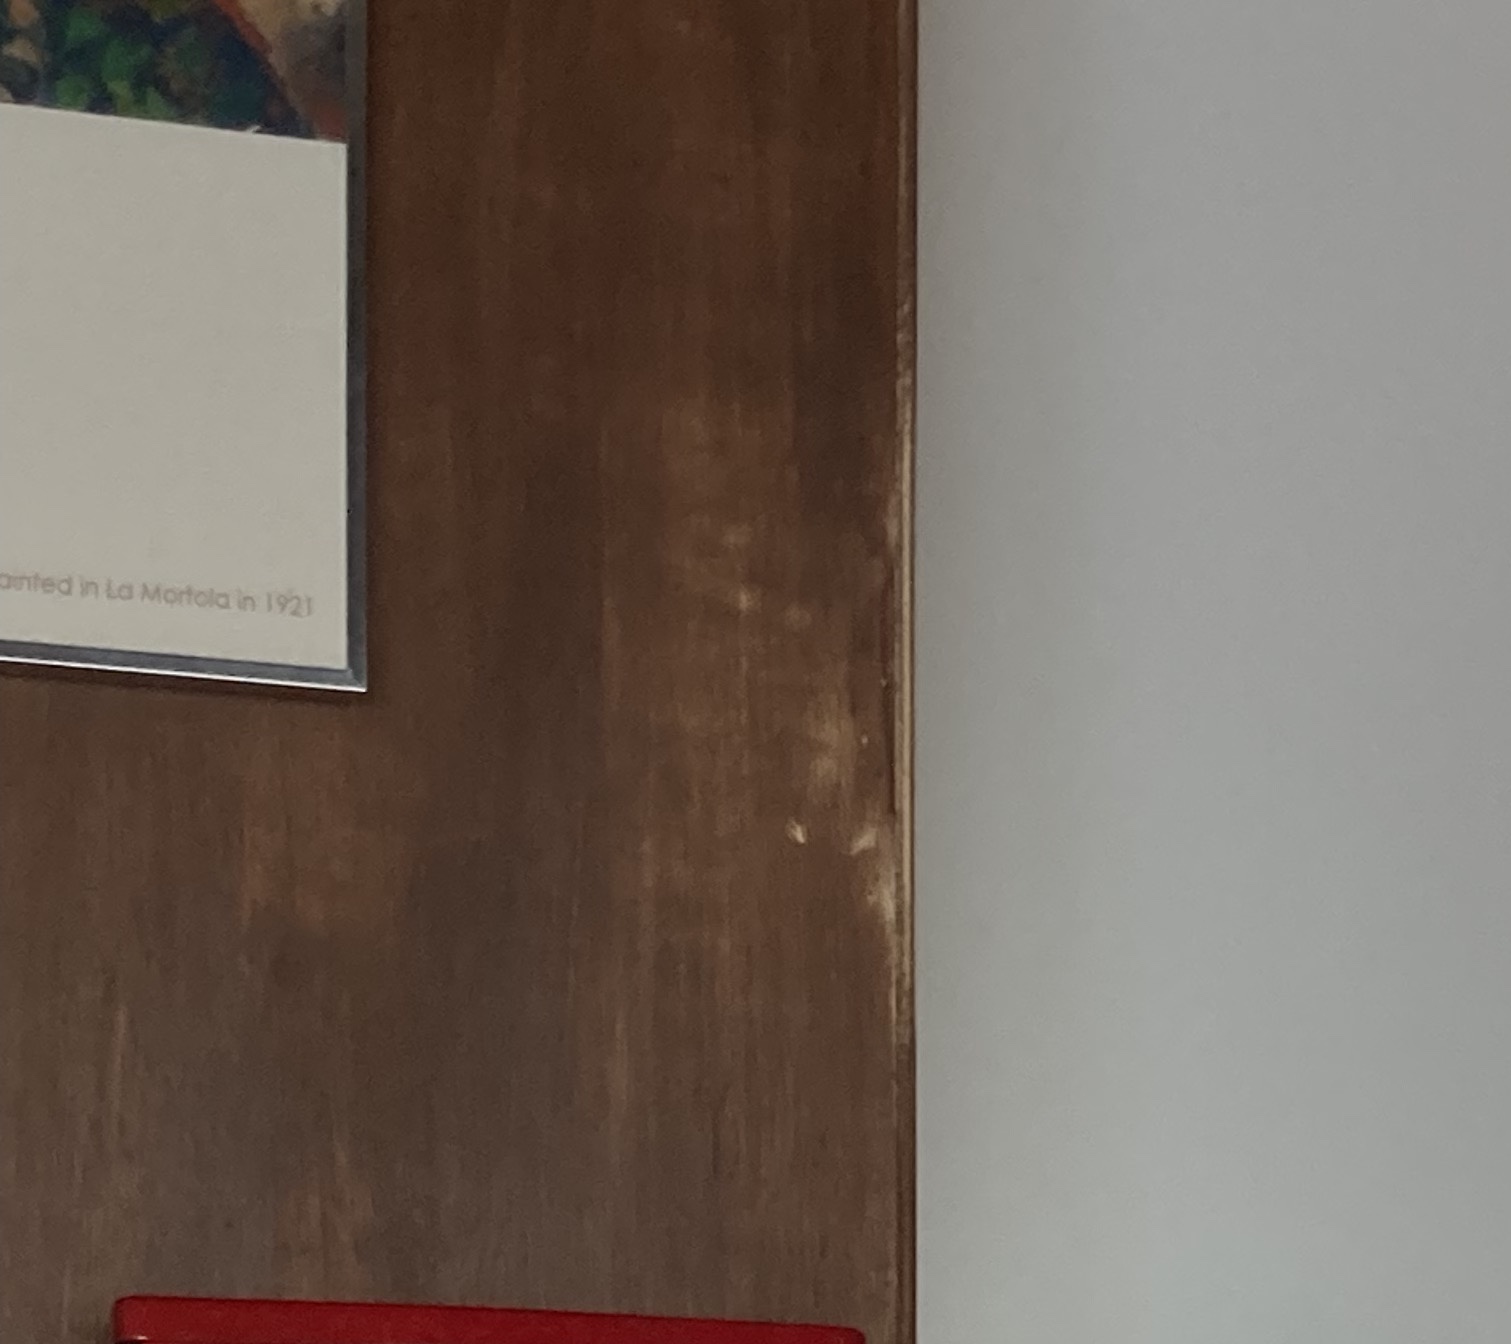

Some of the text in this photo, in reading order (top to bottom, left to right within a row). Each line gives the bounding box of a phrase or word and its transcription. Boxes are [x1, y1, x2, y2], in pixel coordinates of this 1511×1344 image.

[80, 576, 100, 599] in
[106, 578, 134, 602] La
[238, 590, 258, 613] in
